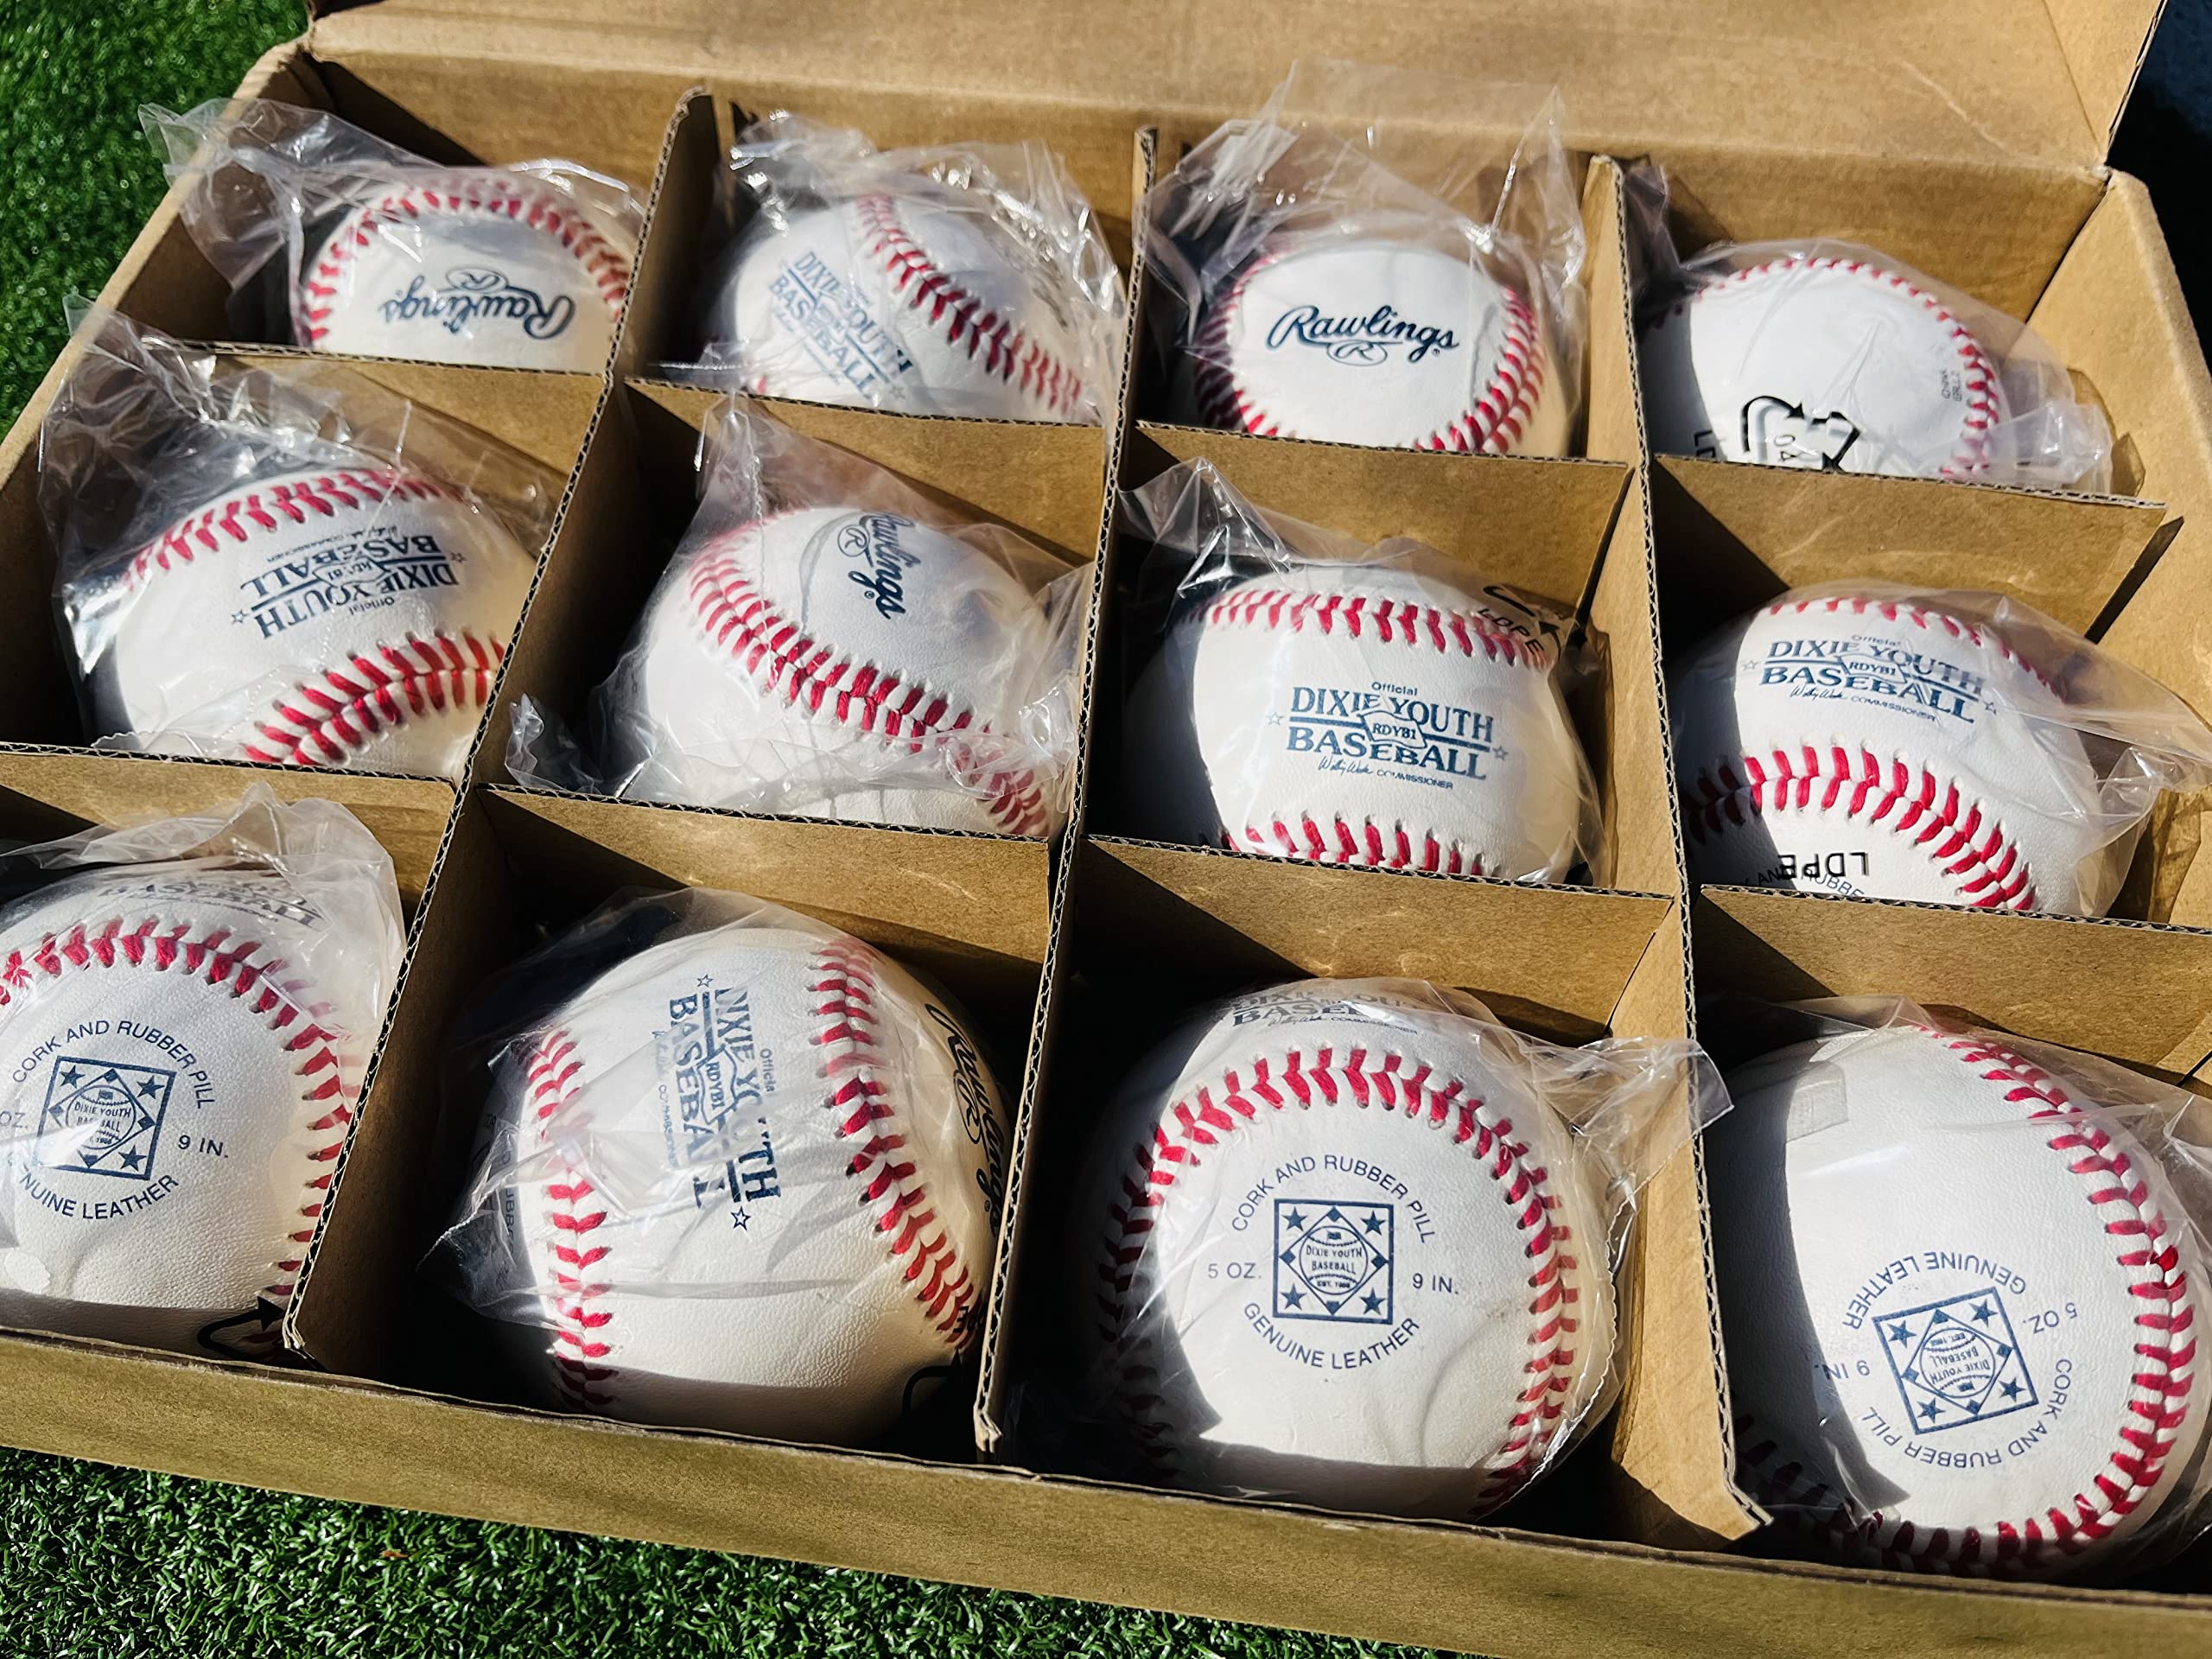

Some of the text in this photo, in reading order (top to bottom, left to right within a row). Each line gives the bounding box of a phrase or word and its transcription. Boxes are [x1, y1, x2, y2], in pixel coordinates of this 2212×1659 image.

[380, 275, 576, 340] Rawlings
[1266, 305, 1459, 363] Rawlings
[239, 535, 443, 598] BASEBALL
[254, 563, 460, 639] DIXIE YOUTH
[1478, 607, 1545, 656] LDPE
[1370, 681, 1418, 696] Official
[1768, 639, 1986, 697] DIXIE YOUTH
[1290, 686, 1495, 744] DIXIE YOUTH
[1759, 666, 1975, 724] BASEBALL
[1285, 726, 1487, 780] BASEBALL
[1777, 851, 1871, 880] LDPE
[1801, 866, 1866, 897] RUBBE
[12, 1020, 215, 1109] CORK AND RUBBER PILL
[760, 1047, 776, 1093] Officia
[74, 1101, 132, 1118] DIXIE YOUTH
[178, 1135, 229, 1159] 9 IN.
[82, 1174, 179, 1220] LEATHER
[1231, 1154, 1435, 1244] CORK AND RUBBER PILL
[1207, 1262, 1262, 1280] 5 OZ.
[1306, 1244, 1363, 1258] DIXIE YOUTH
[1312, 1261, 1357, 1275] BASEBALL
[1412, 1272, 1459, 1295] 9 IN.
[1842, 1251, 2027, 1331] GENUINE LEATHER
[1243, 1302, 1421, 1370] GENUINE LEATHER
[2022, 1302, 2079, 1335] 5 OZ.
[1929, 1345, 1979, 1368] BASEBALL
[1929, 1358, 1991, 1385] DIXIE YOUTH
[1861, 1358, 2073, 1469] CORK AND RUBBER PILL
